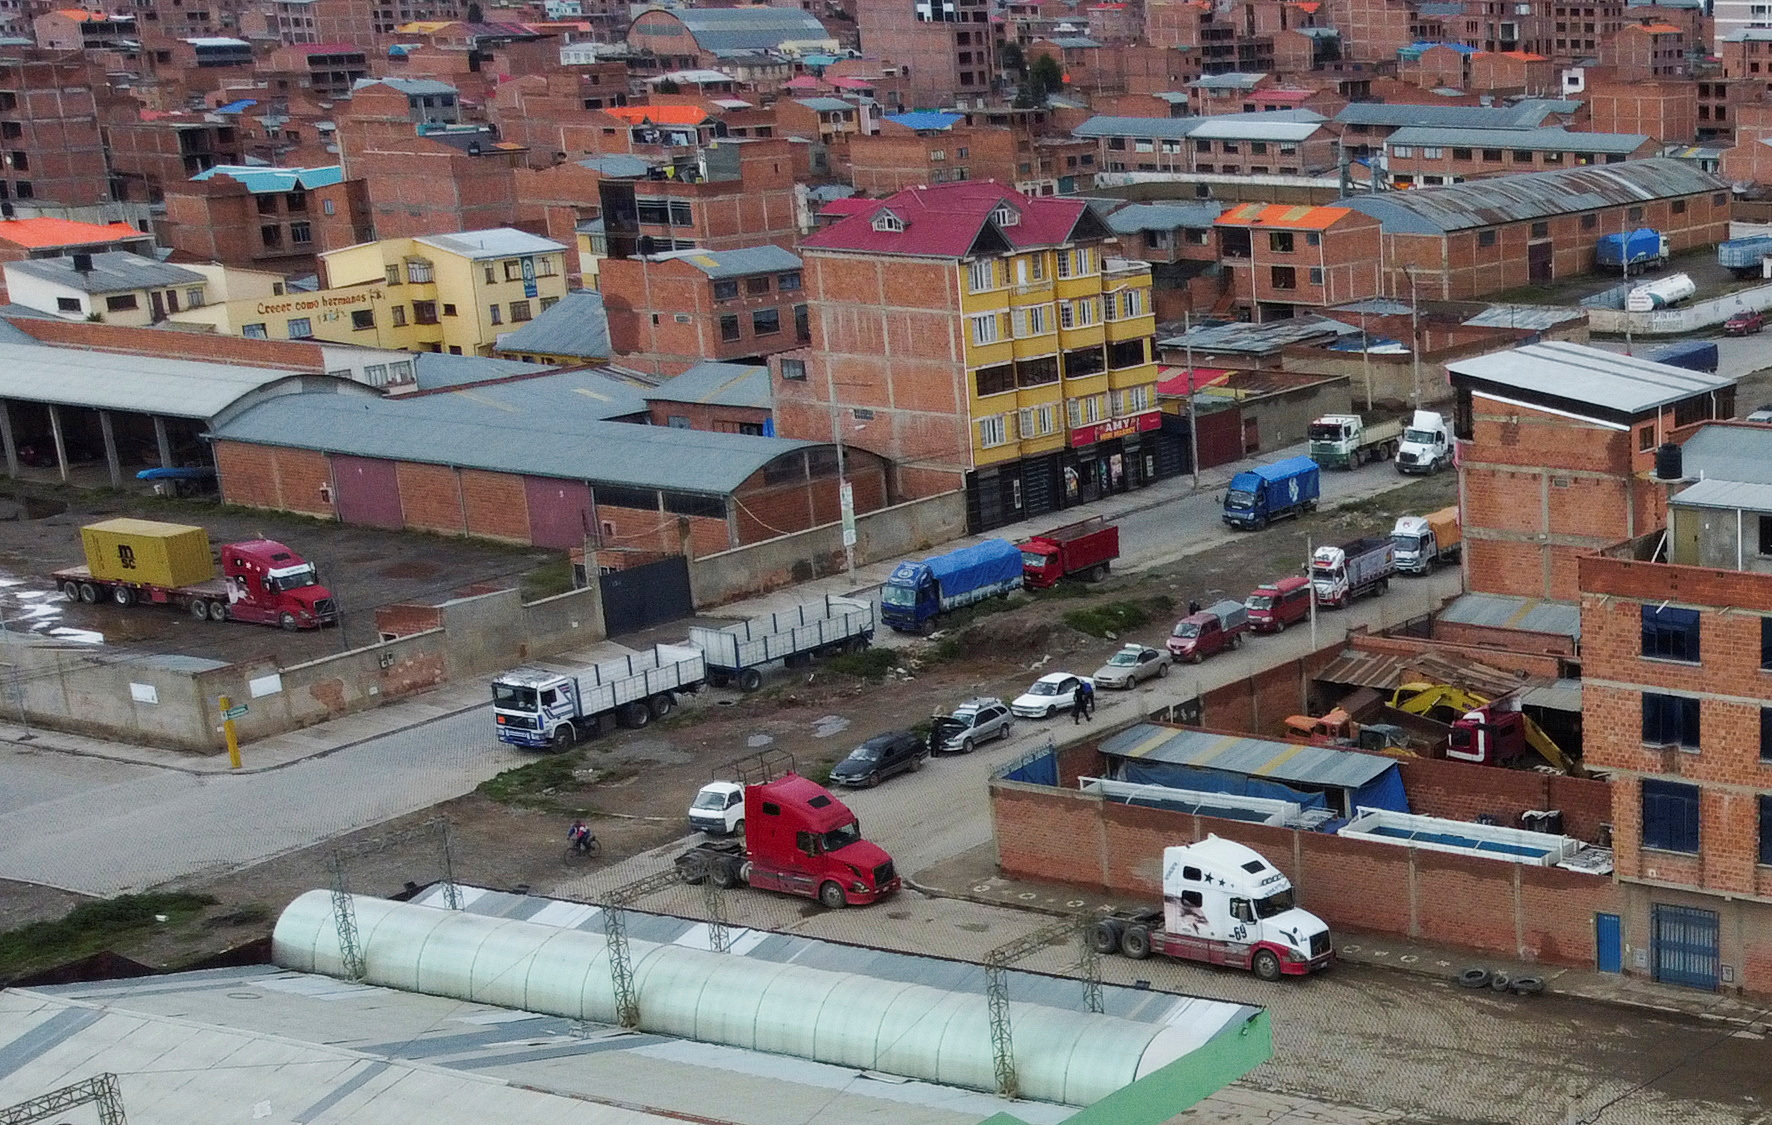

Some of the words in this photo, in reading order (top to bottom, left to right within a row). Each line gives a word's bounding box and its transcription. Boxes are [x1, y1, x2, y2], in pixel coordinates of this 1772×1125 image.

[257, 302, 292, 315] Crecer
[295, 299, 320, 311] como
[322, 293, 366, 307] hermanos
[1105, 418, 1130, 432] AMY
